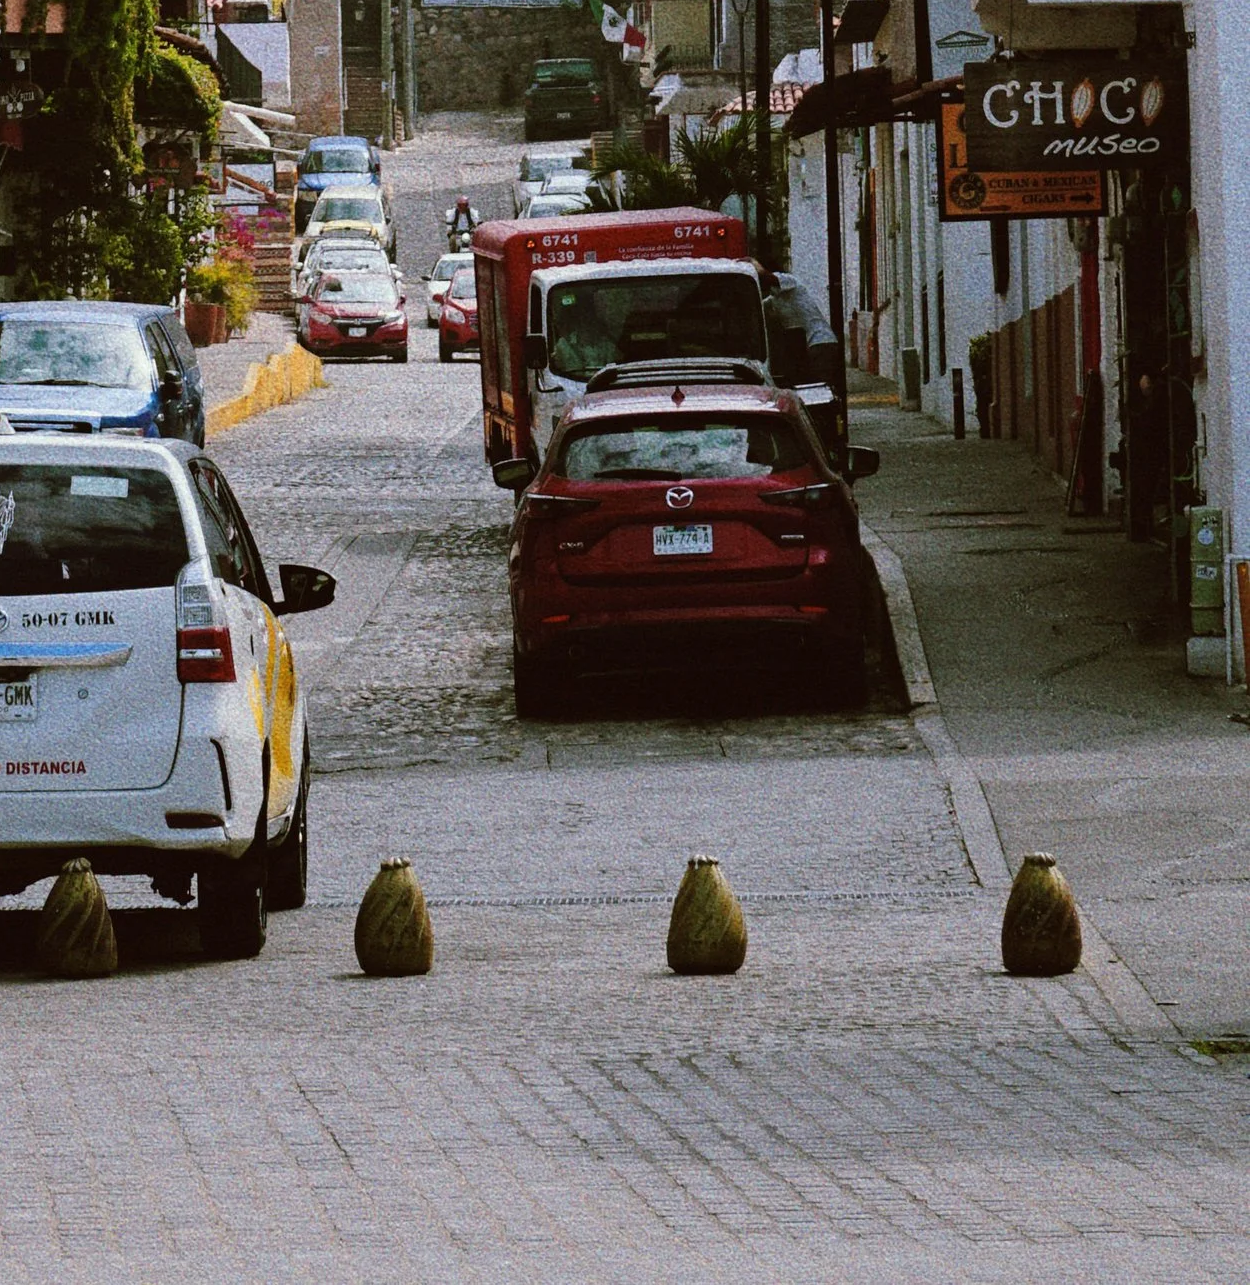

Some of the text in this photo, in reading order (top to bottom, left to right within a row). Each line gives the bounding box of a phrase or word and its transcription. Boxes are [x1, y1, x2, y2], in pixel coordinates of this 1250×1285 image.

[989, 178, 1031, 189] CUBAN
[1044, 175, 1097, 188] MEXICAN
[1022, 194, 1066, 205] CIGARS
[674, 226, 710, 239] 6741
[543, 234, 578, 247] 6741
[531, 250, 575, 265] R-339
[22, 613, 69, 628] 50-07
[75, 611, 116, 626] GMK
[6, 761, 87, 775] DISTANCIA
